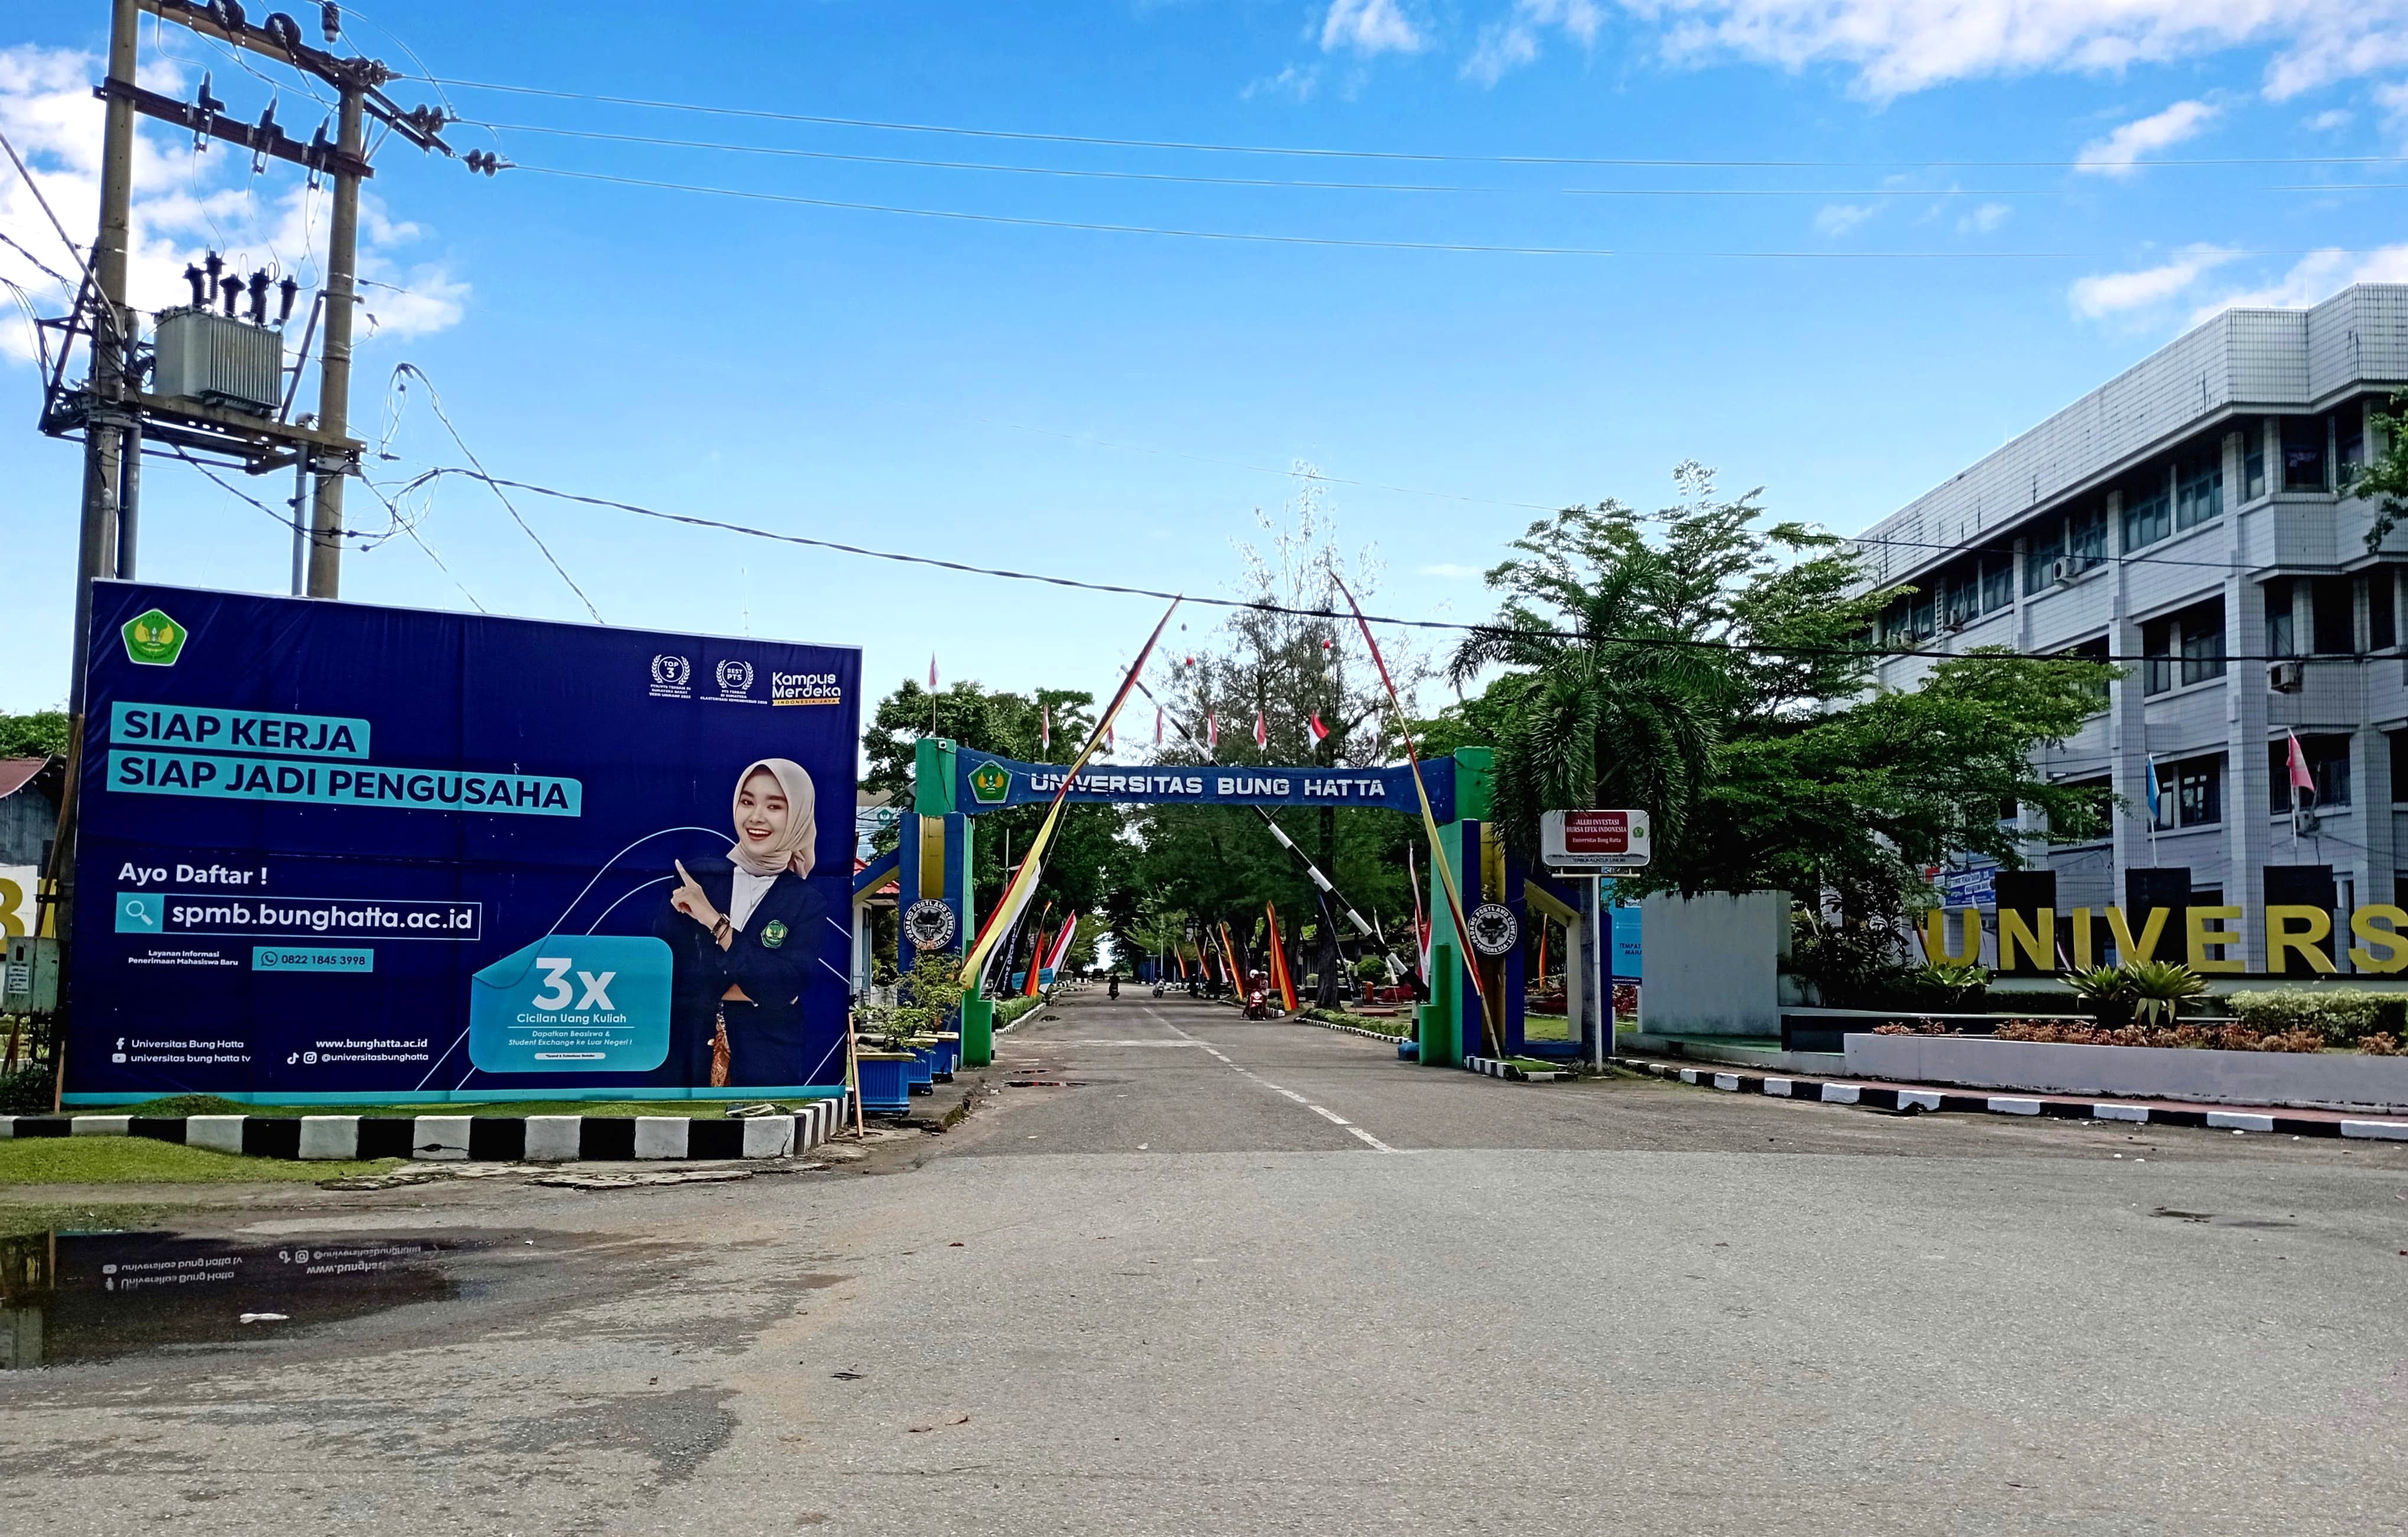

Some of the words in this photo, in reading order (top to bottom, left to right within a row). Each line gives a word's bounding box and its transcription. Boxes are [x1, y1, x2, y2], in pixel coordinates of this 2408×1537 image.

[666, 667, 675, 678] 3
[772, 672, 836, 688] Kampus
[772, 684, 841, 698] Merdeka
[122, 710, 221, 743] SIAP
[231, 718, 357, 753] KERJA
[119, 757, 217, 789] SIAP
[224, 764, 316, 796] JADI
[328, 770, 569, 809] PENGUSAHA
[1218, 777, 1290, 794] BUNG
[1304, 779, 1385, 796] HATTA
[118, 862, 168, 886] Ayo
[176, 864, 253, 884] Daftar
[260, 867, 267, 885] !
[172, 902, 472, 931] spmb.bunghatta.ac.id
[912, 901, 947, 911] PORTLAND
[944, 911, 954, 939] CEMENT
[1475, 906, 1509, 917] PORTLAND
[1507, 917, 1516, 944] CEMENT
[1927, 904, 2408, 974] UNIVERS
[282, 954, 308, 964] 0822
[312, 955, 336, 964] 1845
[339, 956, 365, 965] 3998
[532, 957, 617, 1011] 3x
[516, 1013, 557, 1023] Cicilan
[560, 1013, 590, 1025] Uang
[593, 1013, 627, 1023] Kuliah
[132, 1039, 187, 1048] Universitas
[189, 1039, 215, 1049] Bung
[217, 1040, 244, 1048] Hatta
[316, 1039, 428, 1050] www.bunghatta.ac.id
[187, 1054, 212, 1064] bung
[322, 1053, 429, 1062] @universitasbunghatta
